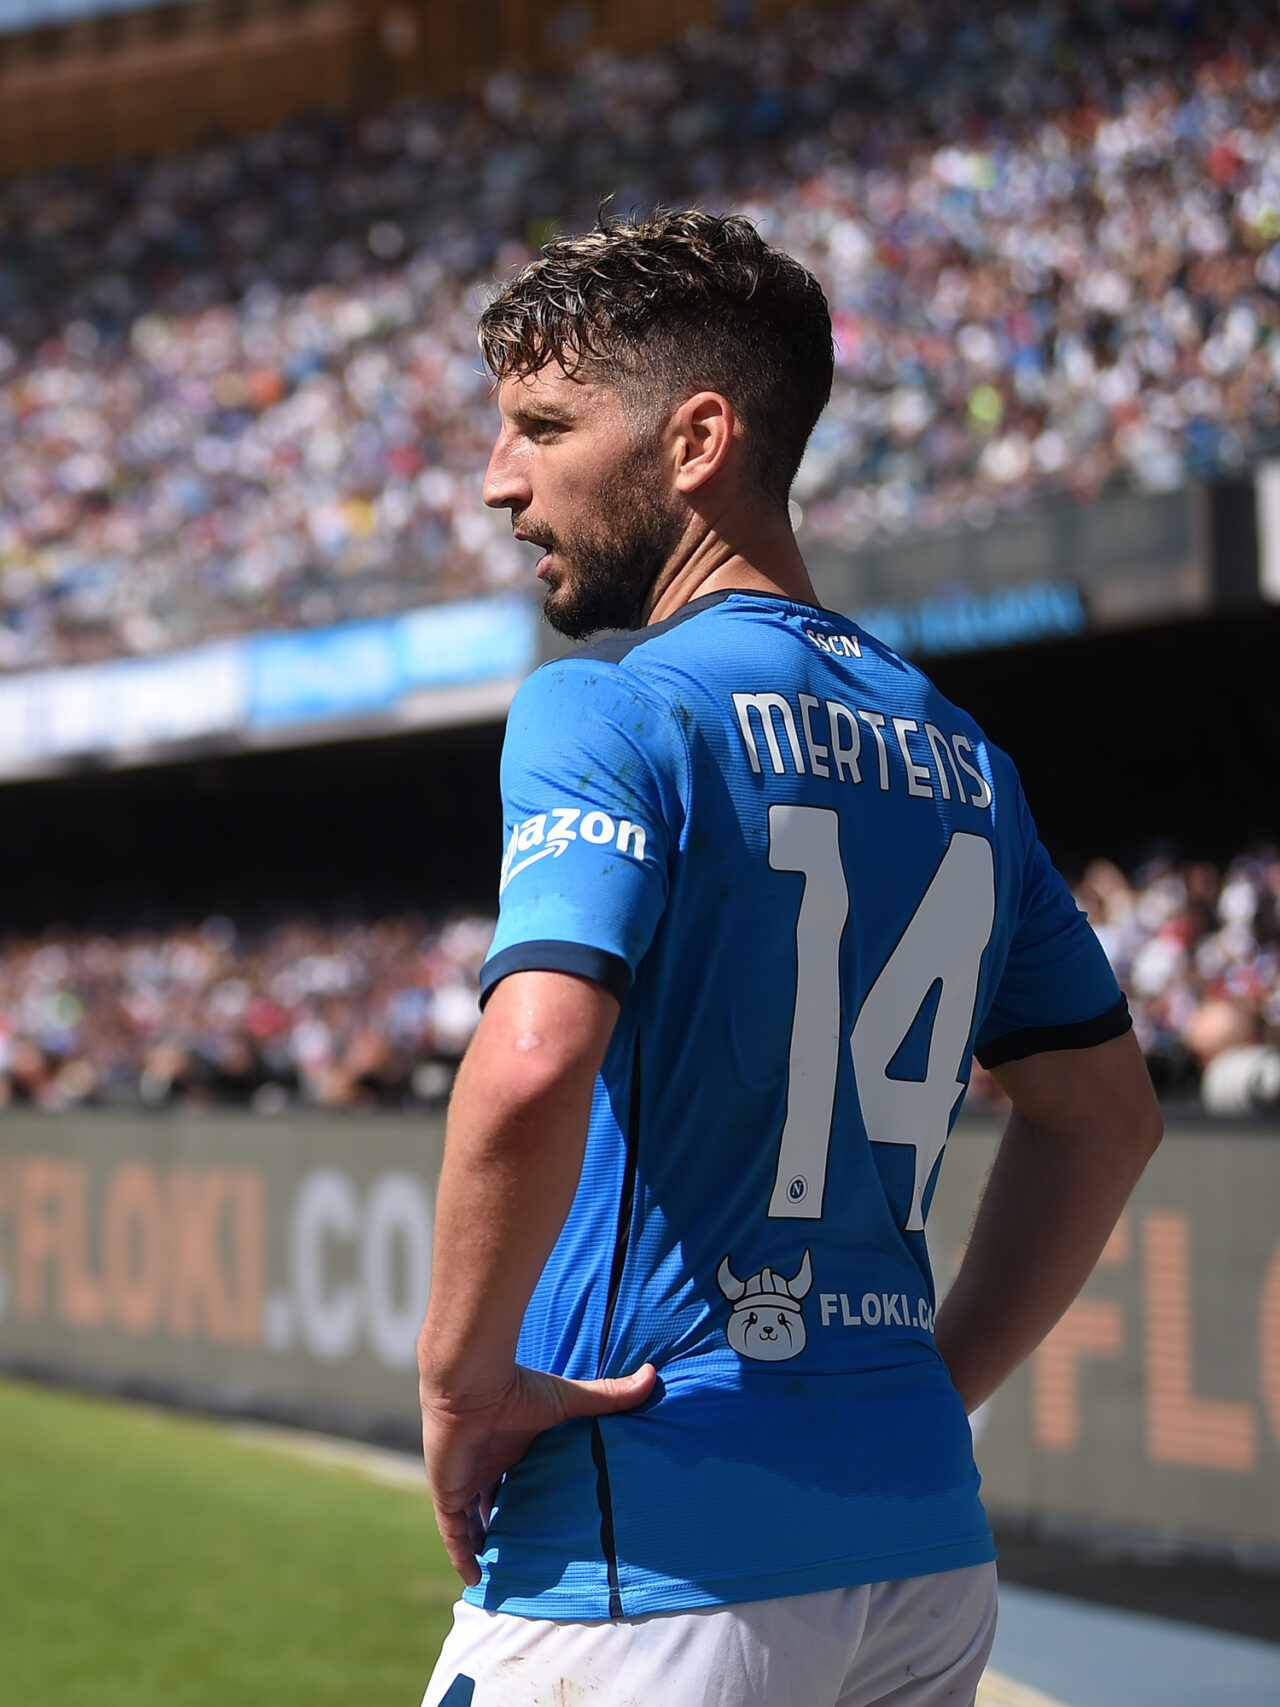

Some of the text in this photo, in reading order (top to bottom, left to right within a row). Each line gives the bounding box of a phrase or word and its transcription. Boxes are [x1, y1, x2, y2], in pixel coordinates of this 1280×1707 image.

[806, 629, 862, 658] SSCN
[731, 692, 992, 809] MERTENS
[768, 804, 996, 1231] 14
[14, 1156, 432, 1368] FLOKI.CO
[819, 1292, 935, 1334] FLOKI.CO
[1031, 1209, 1280, 1473] FL
